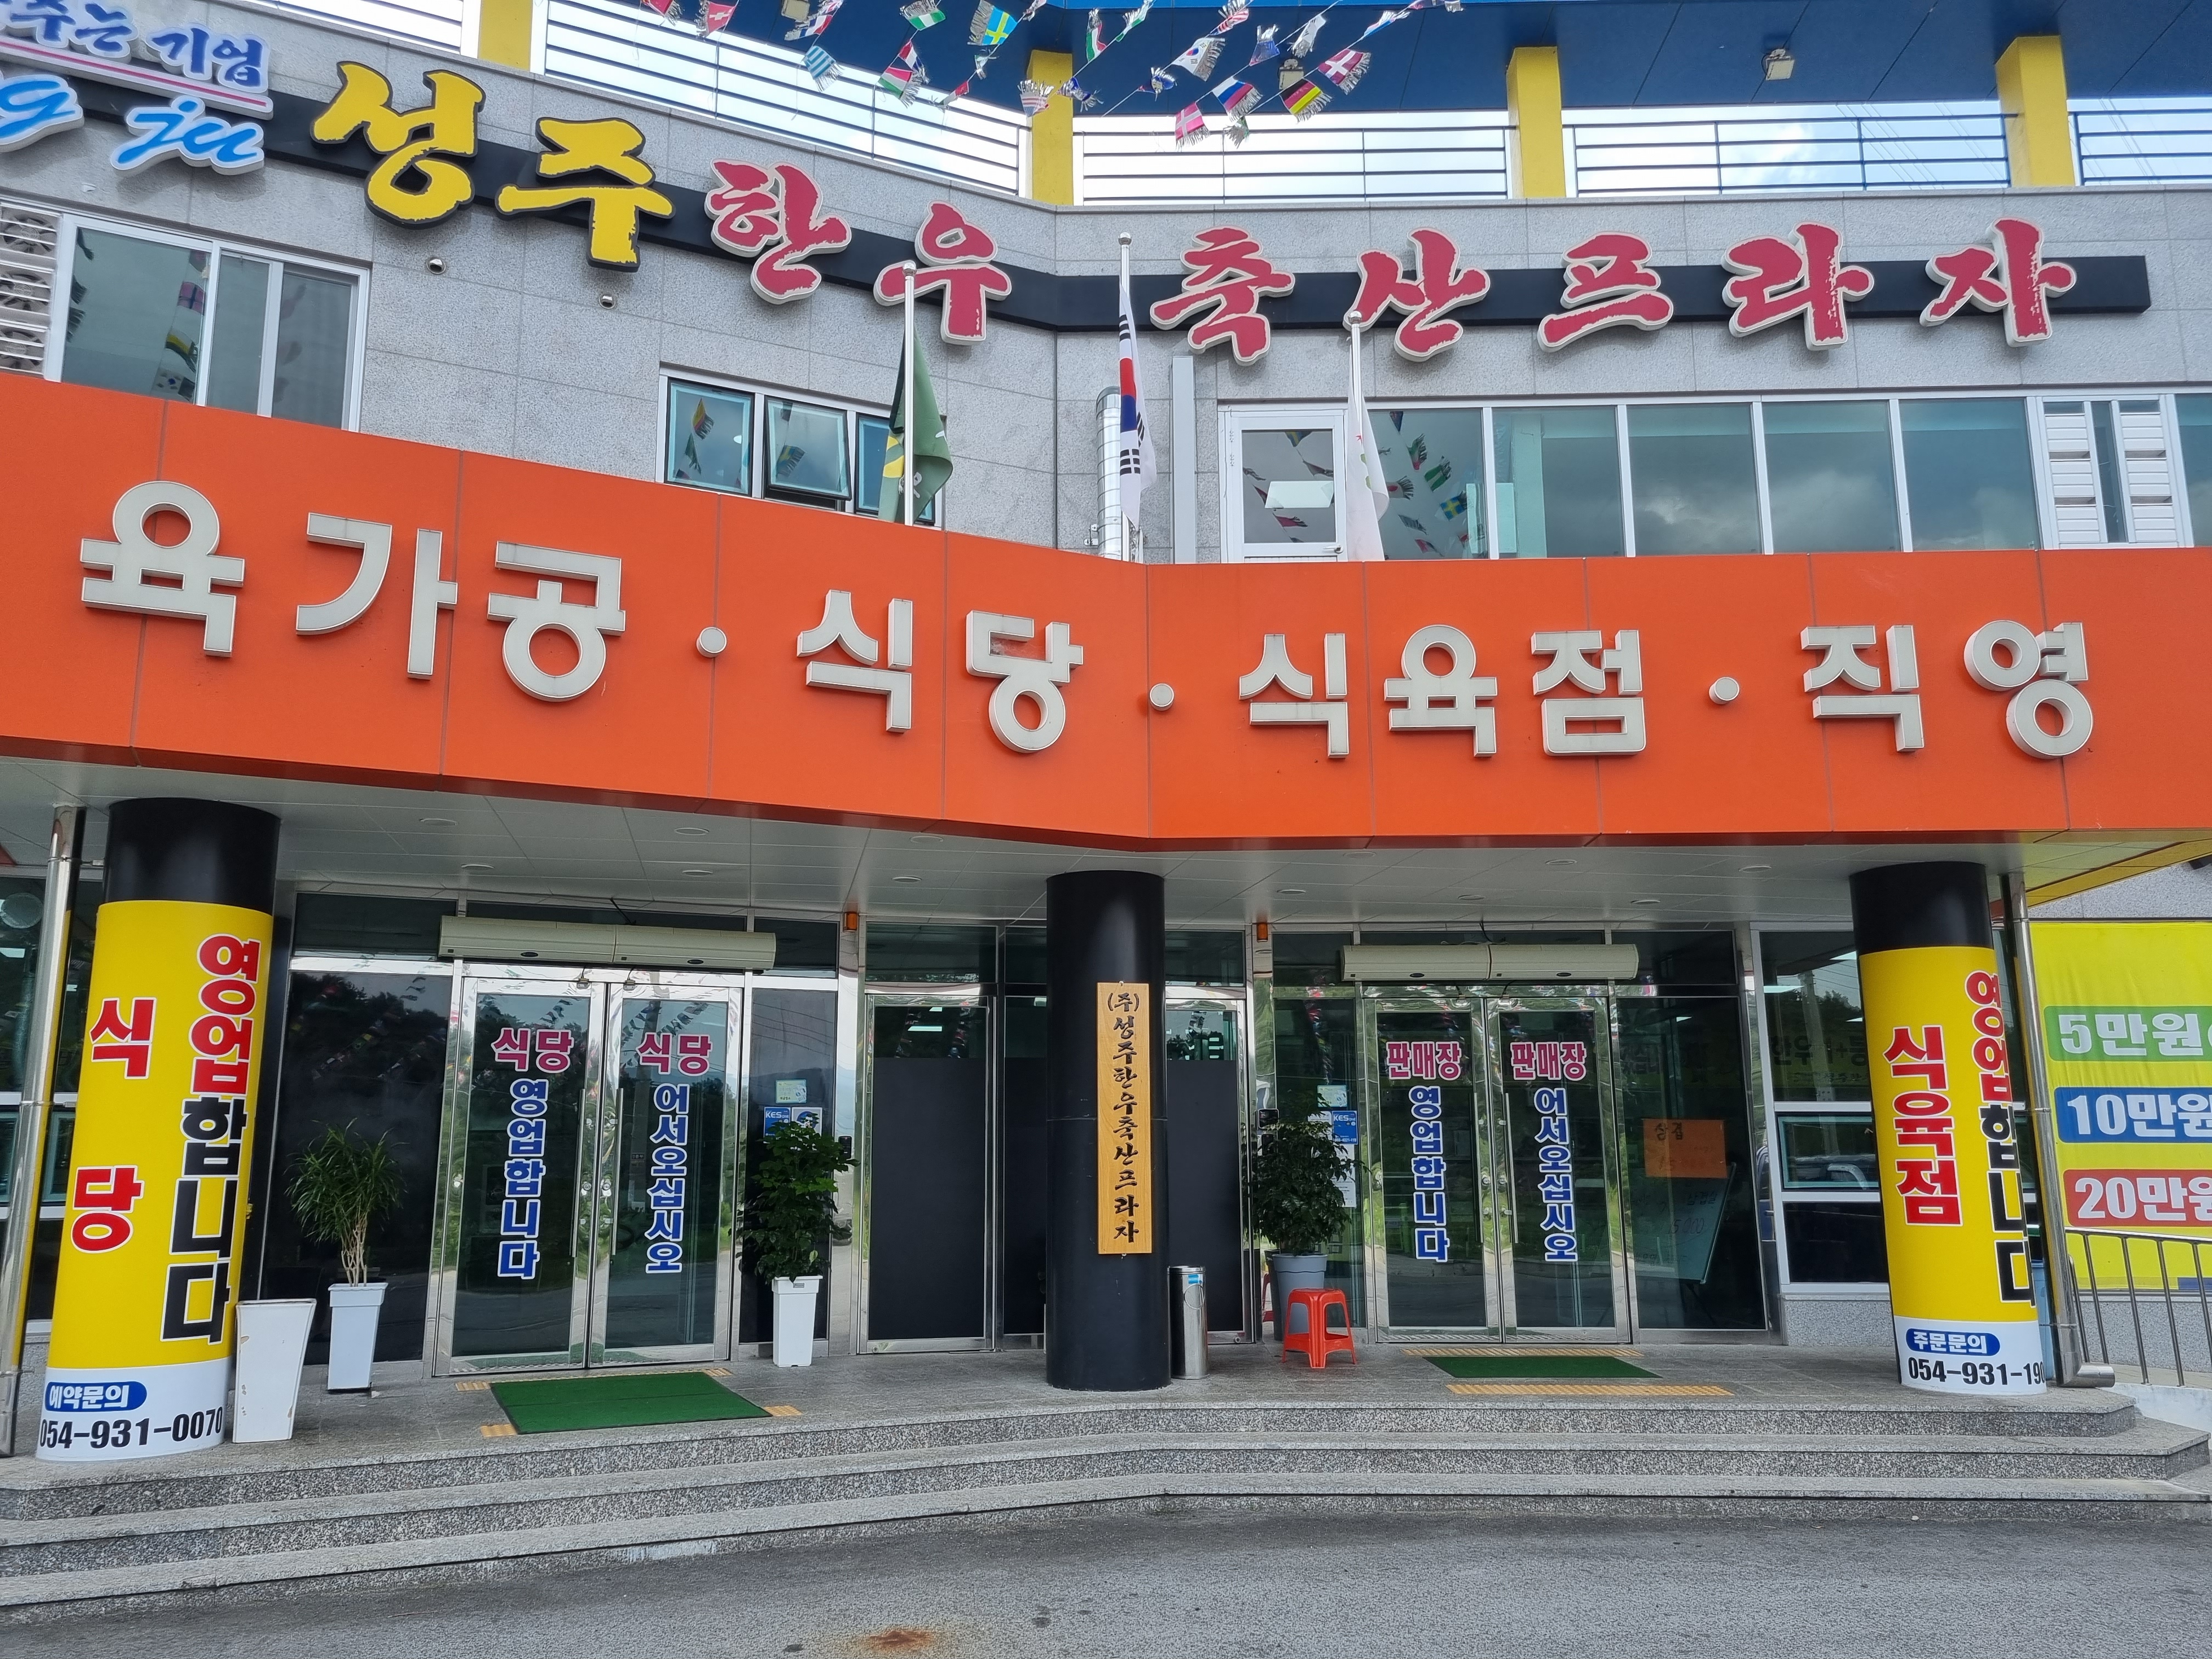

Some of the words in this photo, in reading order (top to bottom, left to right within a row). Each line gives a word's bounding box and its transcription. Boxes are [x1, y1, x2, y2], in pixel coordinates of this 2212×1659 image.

[152, 27, 262, 87] 기업
[81, 481, 625, 702] 육가공
[797, 589, 1084, 753] 식당
[1238, 624, 1645, 758] 식육점
[1800, 619, 2094, 760] 직영
[491, 1028, 574, 1073] 식당
[636, 1032, 712, 1076] 식당
[1386, 1041, 1462, 1080] 판매장
[1510, 1041, 1587, 1081] 판매장
[2058, 1013, 2212, 1056] 5만원
[71, 997, 156, 1253] 식당
[160, 934, 261, 1345] 영업합니다
[497, 1078, 549, 1279] 영업합니다
[645, 1083, 690, 1274] 어서오십시오
[1408, 1085, 1450, 1262] 영업합니다
[1534, 1087, 1578, 1262] 어서오십시오
[1883, 1025, 1963, 1226] 식육점
[1965, 970, 2036, 1308] 영업합니다
[49, 1385, 130, 1409] 예약문의
[1914, 1331, 1988, 1354] 주문문의
[40, 1406, 224, 1449] 054-931-0070
